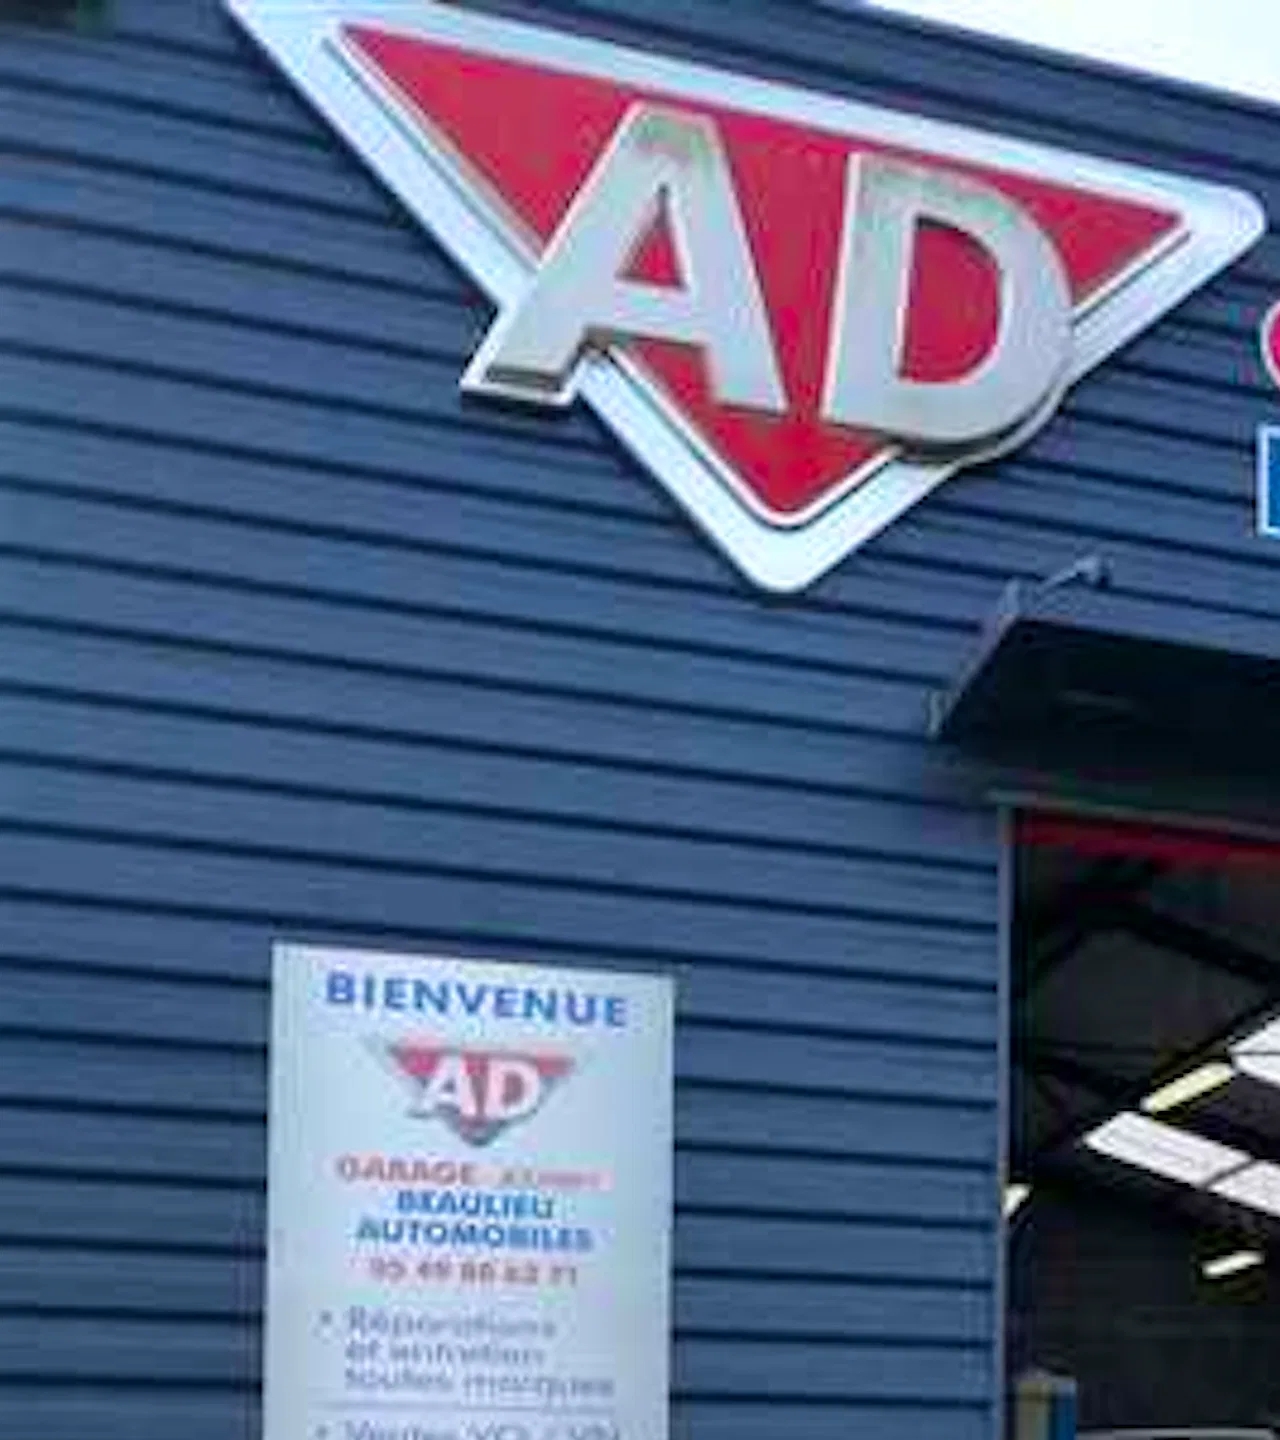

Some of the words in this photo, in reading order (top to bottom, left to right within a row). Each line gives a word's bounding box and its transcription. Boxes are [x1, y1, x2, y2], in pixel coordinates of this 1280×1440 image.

[460, 98, 1075, 460] AD
[324, 970, 630, 1029] BIENVENUE
[407, 1050, 542, 1121] AD
